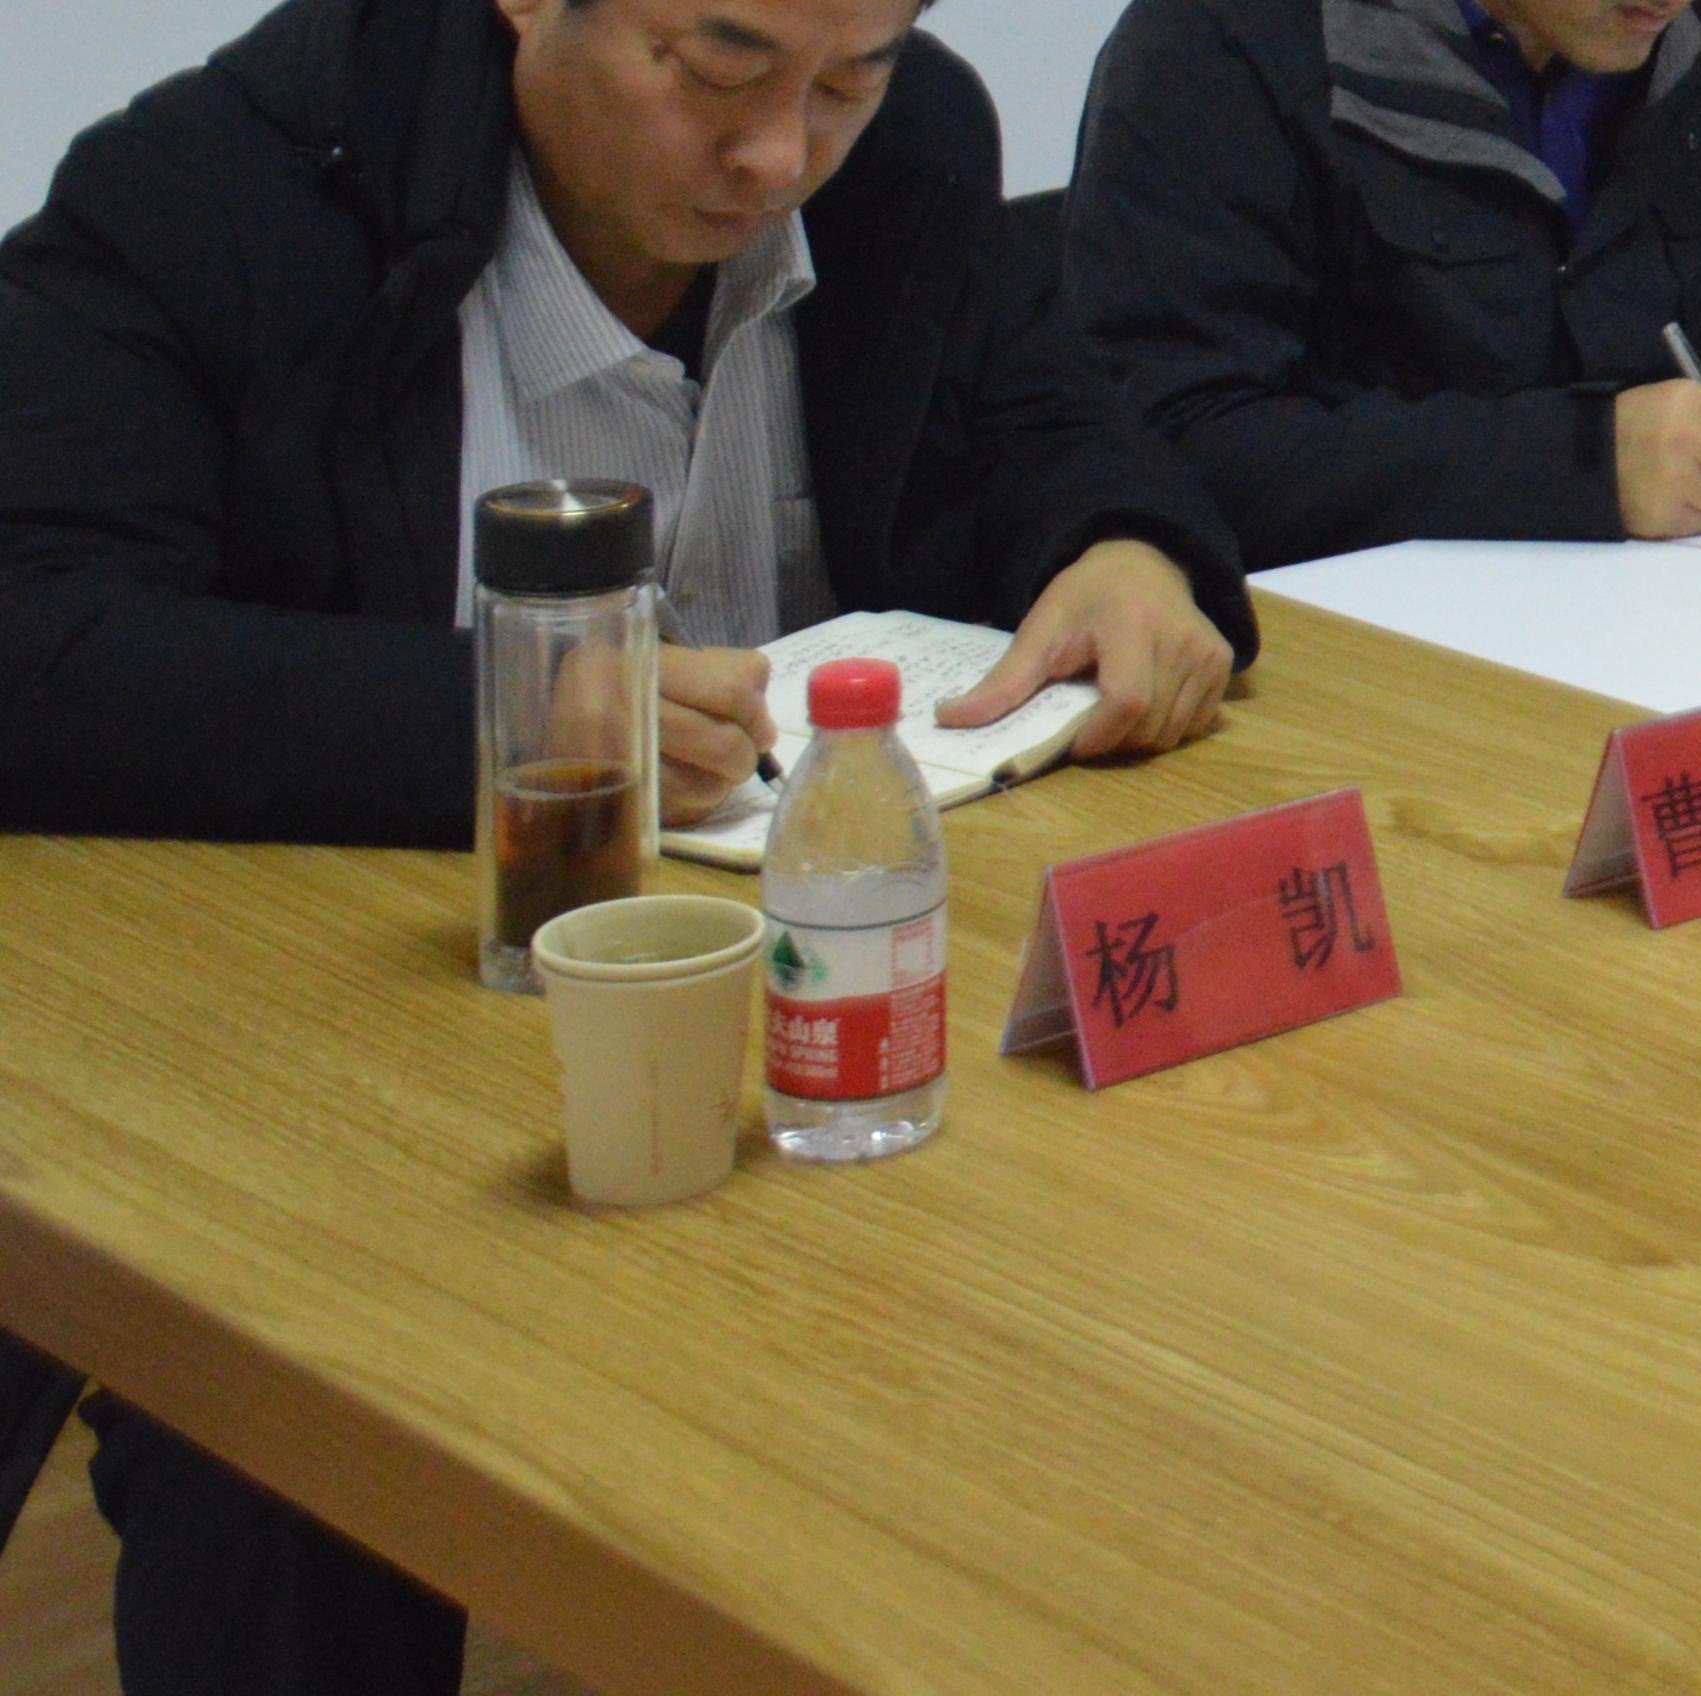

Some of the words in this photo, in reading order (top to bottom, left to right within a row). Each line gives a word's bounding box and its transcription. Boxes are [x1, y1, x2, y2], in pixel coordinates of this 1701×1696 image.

[1084, 860, 1377, 1029] 杨凯
[770, 1008, 840, 1046] 夫山泉
